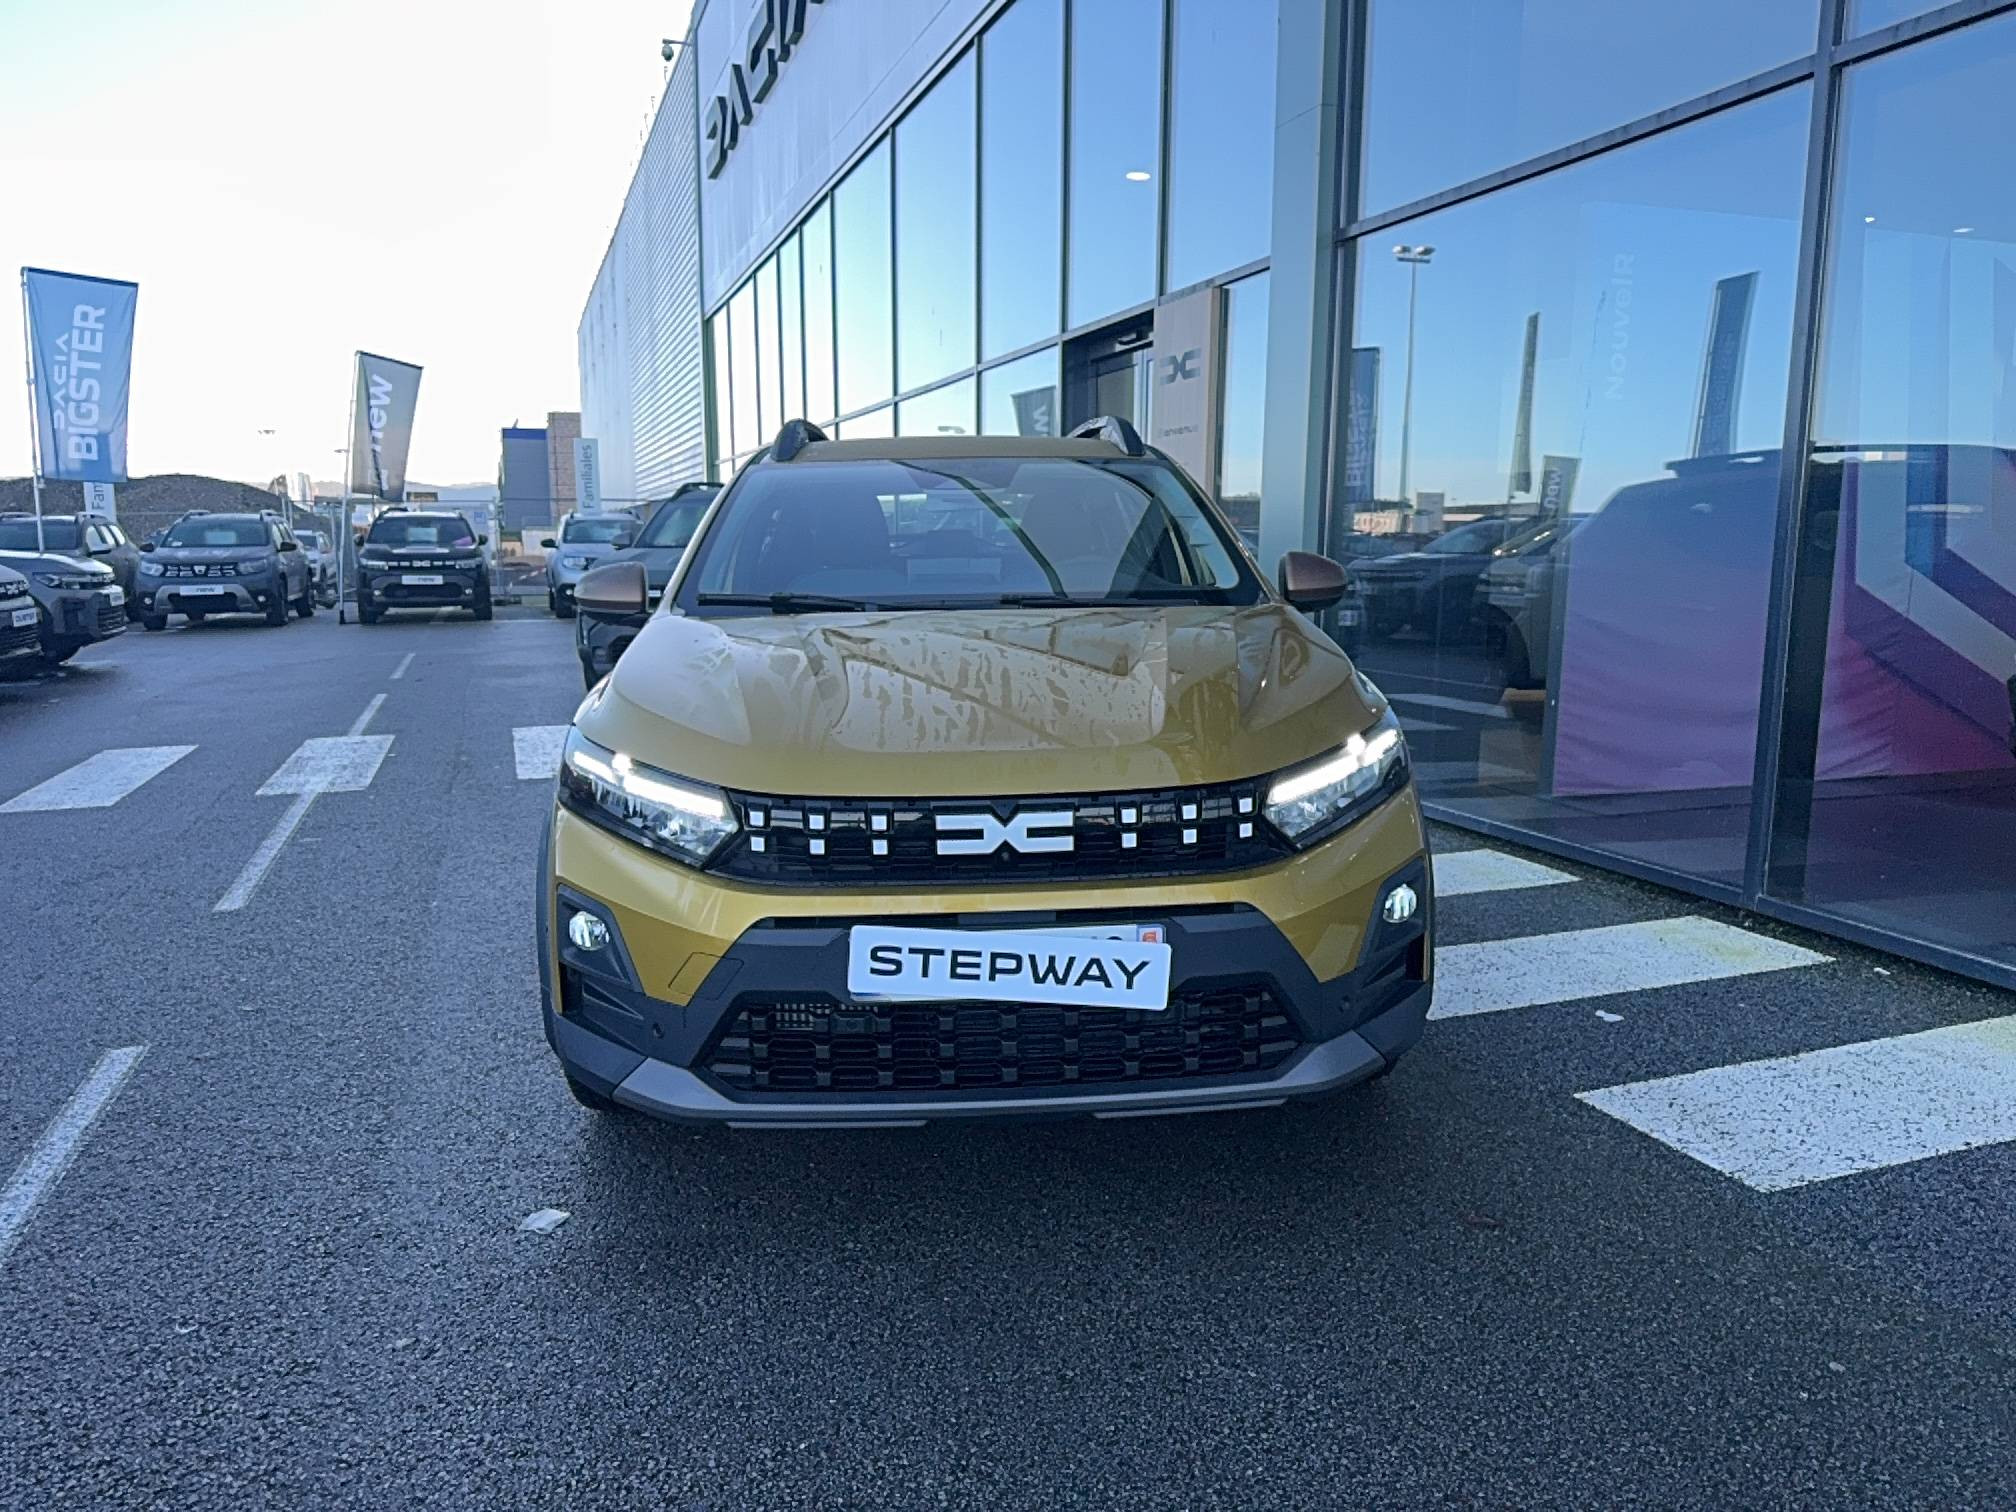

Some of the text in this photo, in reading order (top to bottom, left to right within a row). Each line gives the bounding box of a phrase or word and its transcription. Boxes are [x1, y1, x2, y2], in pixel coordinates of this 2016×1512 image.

[67, 303, 106, 461] BIGSTER
[580, 444, 595, 509] Familiales
[869, 945, 1151, 991] STEPWAY
